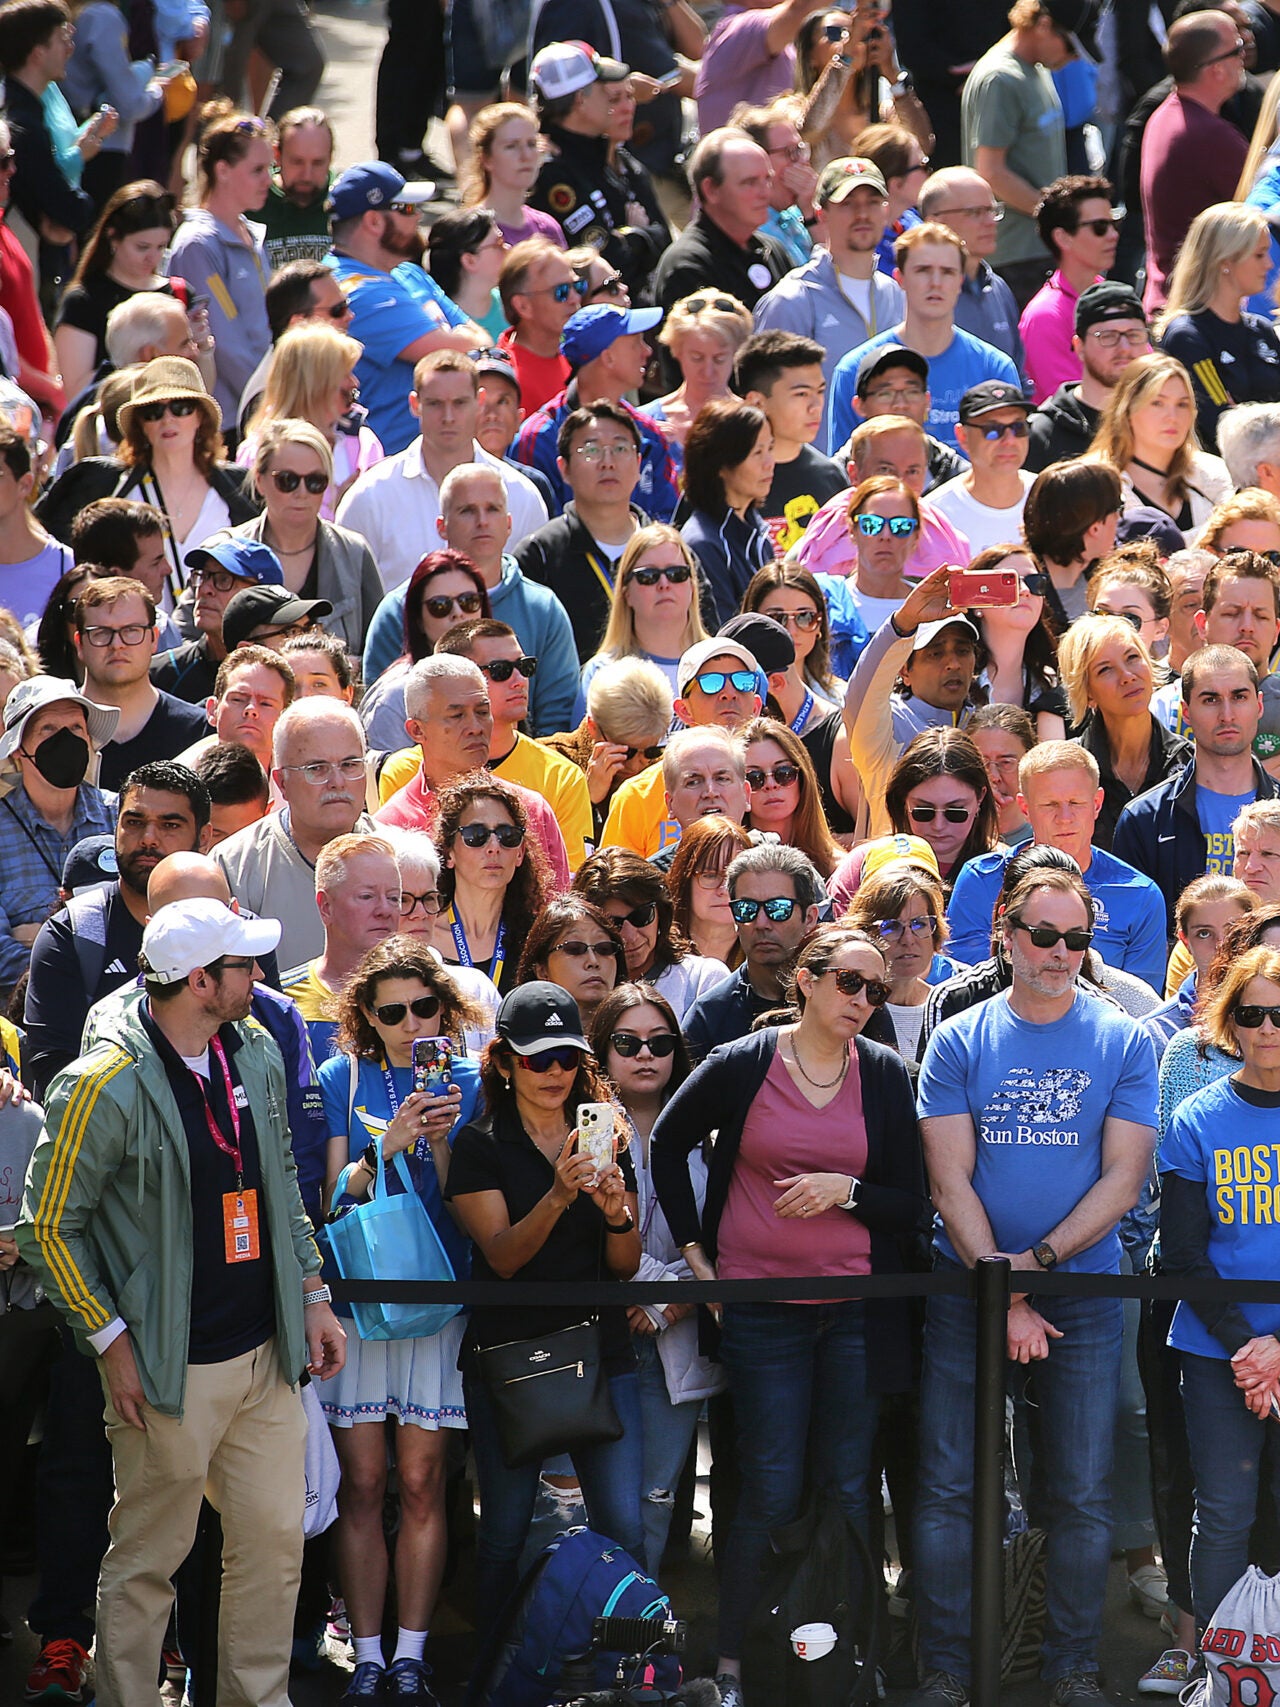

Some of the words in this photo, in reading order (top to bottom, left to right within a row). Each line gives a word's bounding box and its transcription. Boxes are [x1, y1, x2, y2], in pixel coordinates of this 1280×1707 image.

[894, 837, 911, 855] B
[453, 923, 470, 966] ASSOCIATION
[980, 1125, 1013, 1144] Run
[1015, 1125, 1080, 1146] Boston
[529, 1352, 551, 1362] COACH
